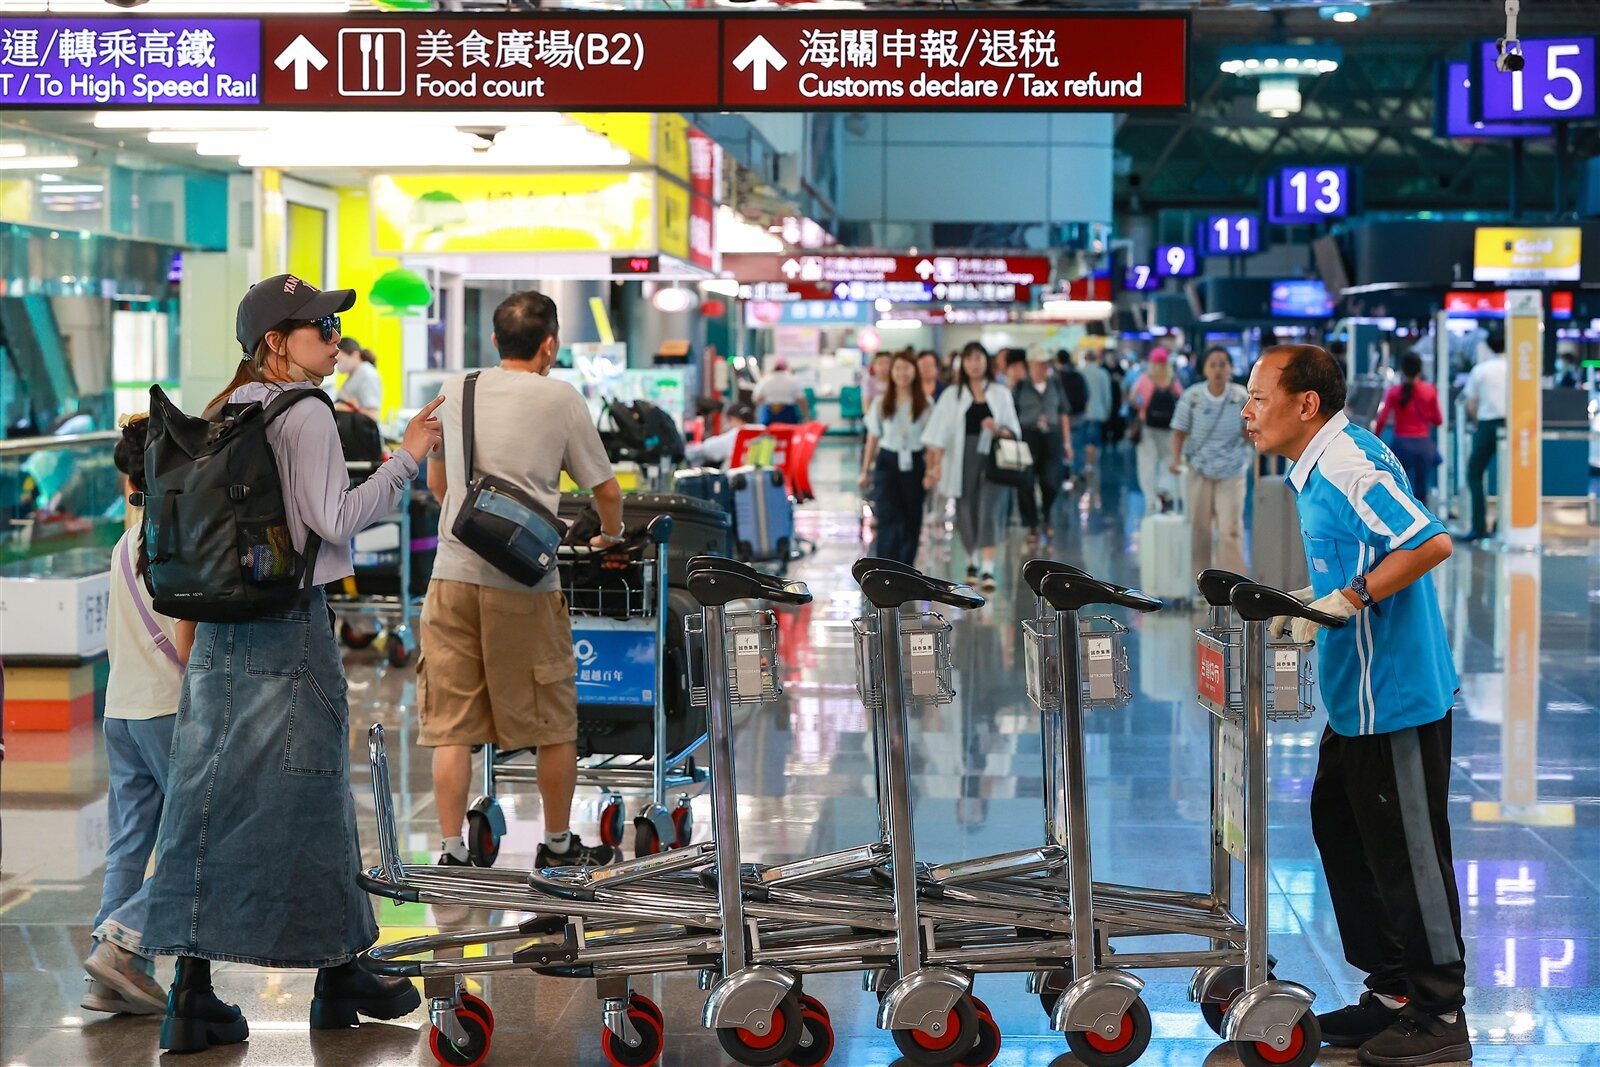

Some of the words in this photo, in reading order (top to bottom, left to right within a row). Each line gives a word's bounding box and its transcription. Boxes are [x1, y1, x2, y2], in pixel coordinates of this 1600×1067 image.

[1, 28, 216, 69] 運/轉乘高鐵
[416, 28, 645, 71] 美食廣場(B2)
[34, 73, 63, 96] To
[70, 72, 126, 103] High
[133, 73, 209, 103] Speed
[216, 73, 257, 98] Rail
[416, 72, 477, 97] Food
[482, 76, 545, 98] court
[798, 72, 904, 98] Customs
[909, 71, 998, 97] declare
[1018, 73, 1059, 97] Tax
[1064, 71, 1142, 97] refund
[1508, 44, 1583, 111] 15
[1289, 170, 1341, 214] 13
[1214, 217, 1250, 251] 11
[1166, 246, 1186, 275] 9
[1134, 265, 1151, 290] 7
